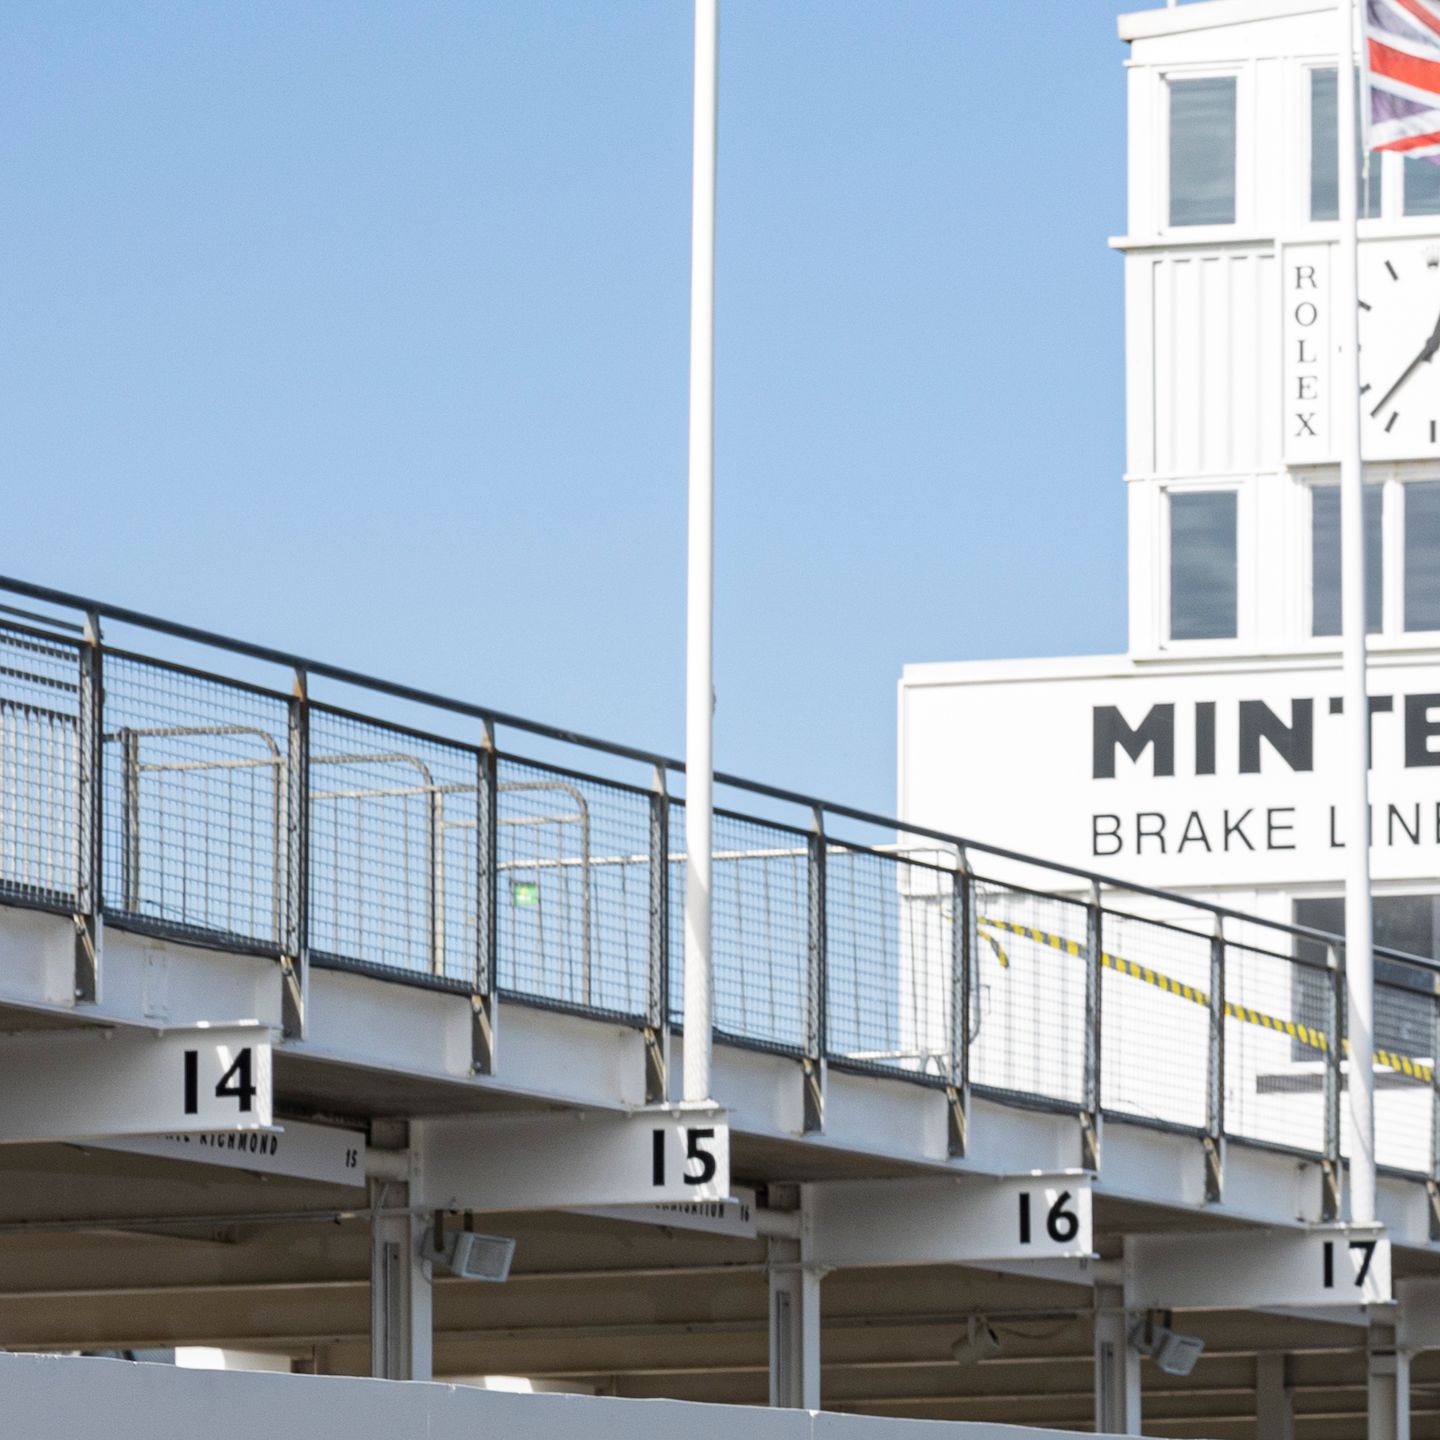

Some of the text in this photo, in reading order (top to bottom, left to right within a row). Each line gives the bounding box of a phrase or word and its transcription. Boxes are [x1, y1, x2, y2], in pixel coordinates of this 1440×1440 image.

[1295, 265, 1318, 436] ROLEX
[1092, 808, 1297, 856] BRAKE
[184, 1048, 256, 1114] 14
[345, 1149, 358, 1168] 15
[653, 1128, 716, 1186] 15
[1019, 1191, 1079, 1243] 16
[1323, 1241, 1377, 1288] 17
